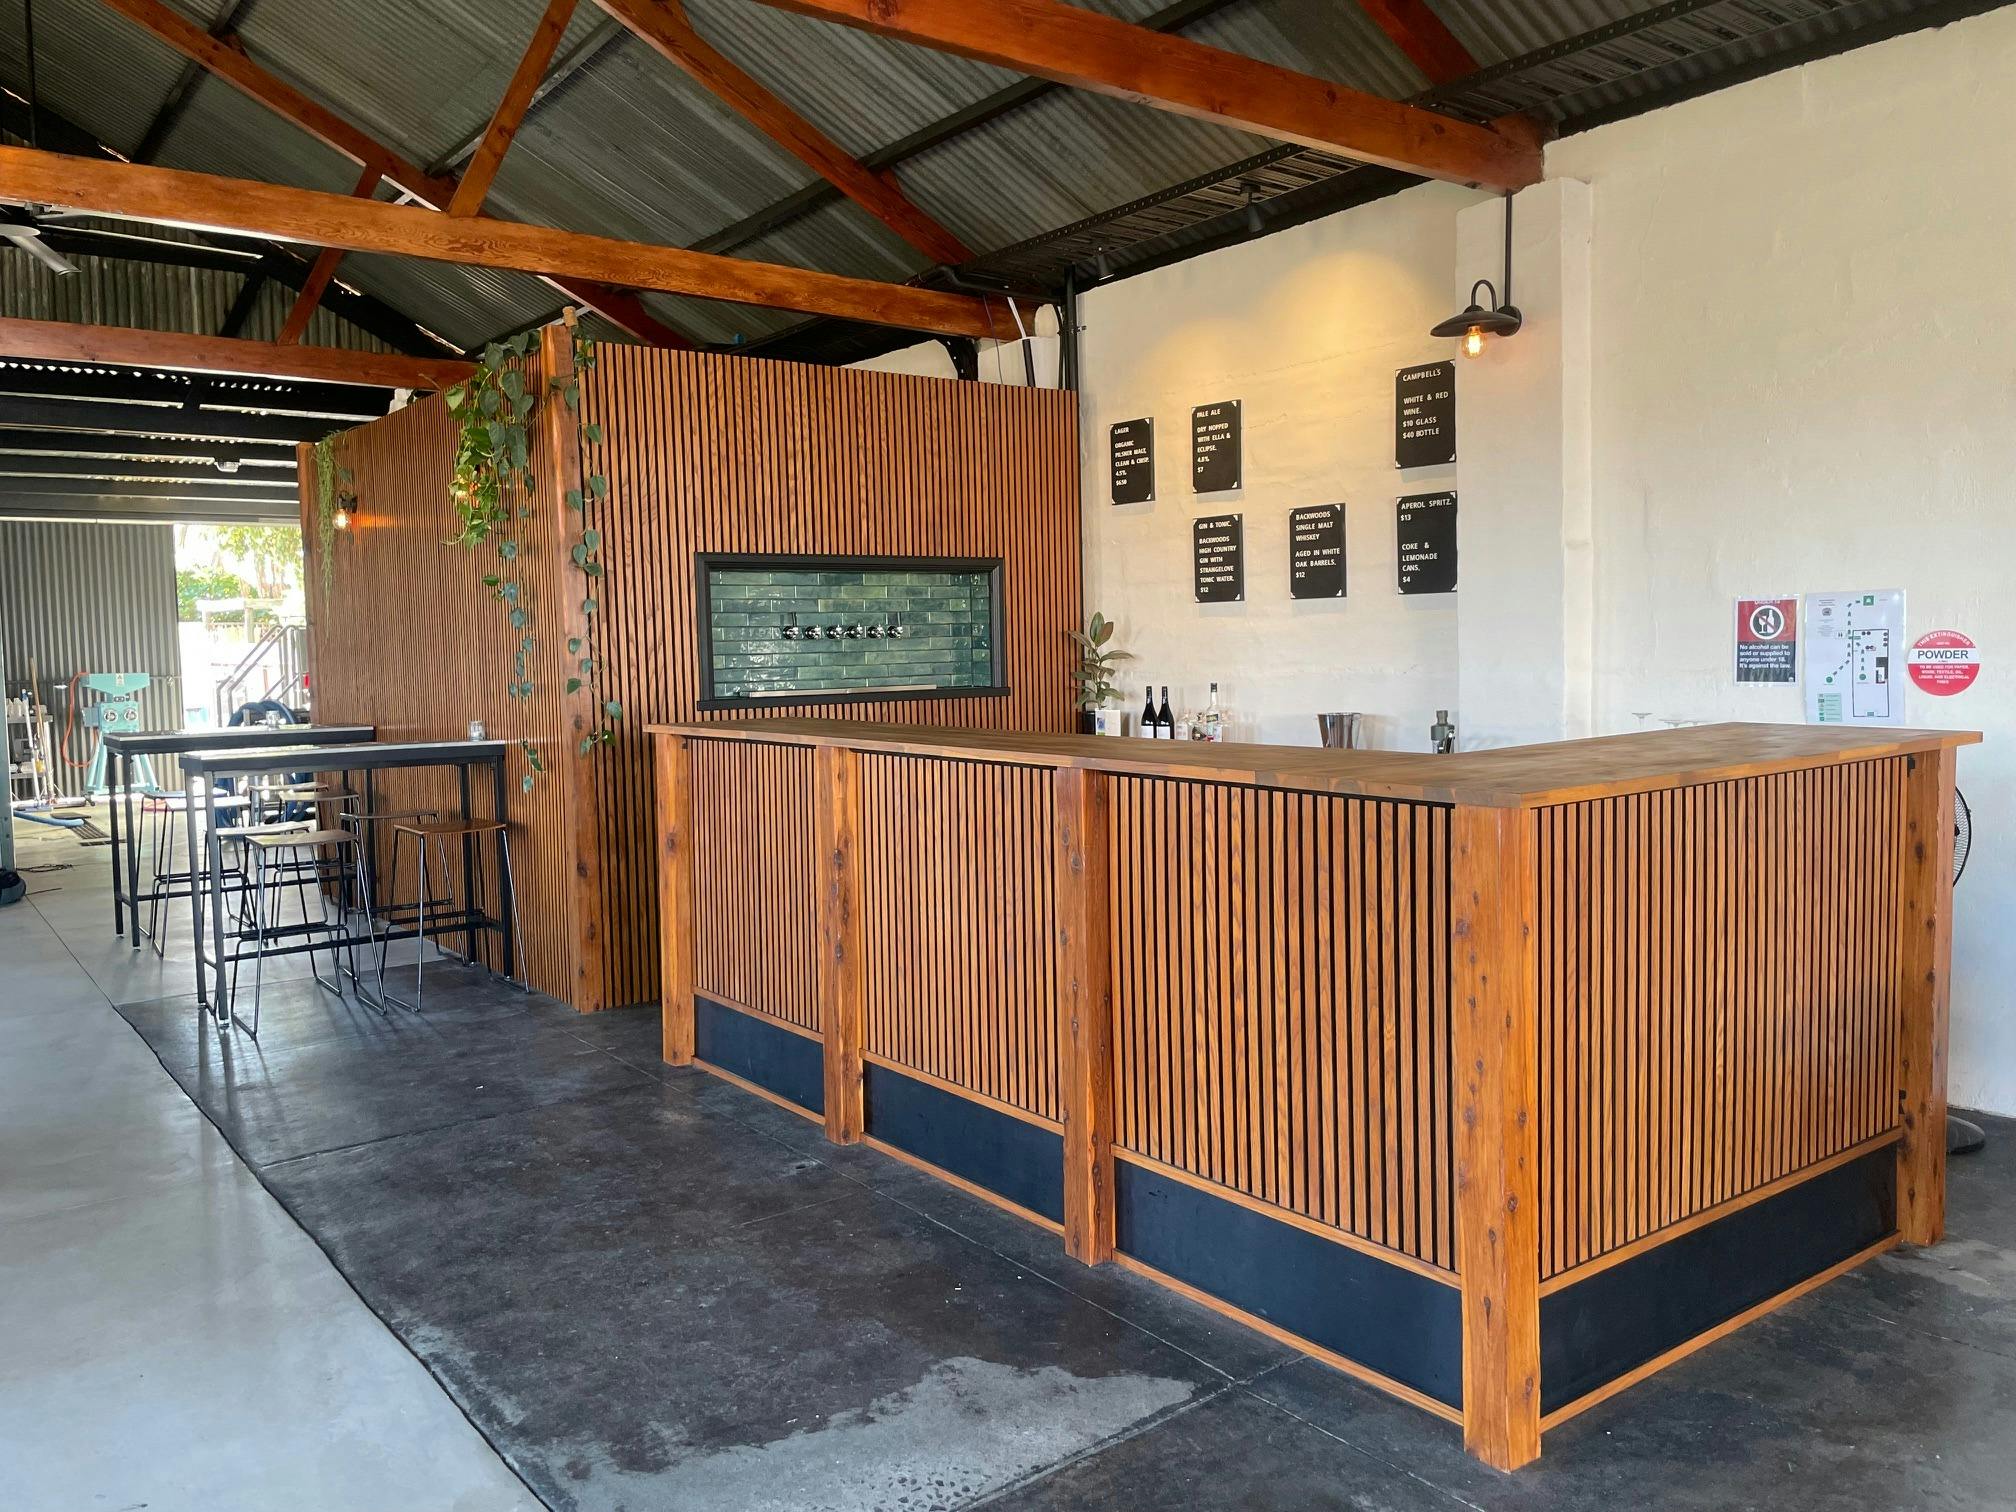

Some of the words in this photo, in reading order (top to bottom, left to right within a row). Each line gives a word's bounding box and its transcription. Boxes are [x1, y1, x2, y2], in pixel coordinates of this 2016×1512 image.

[1402, 368, 1441, 382] CAMPBELL'S
[1403, 394, 1424, 405] WHITE
[1426, 393, 1432, 401] &
[1435, 391, 1449, 400] RED
[1196, 410, 1209, 418] PALE
[1210, 408, 1221, 416] ALE
[1403, 407, 1421, 416] WINE.
[1402, 419, 1414, 428] $10
[1415, 416, 1437, 426] GLASS
[1114, 426, 1130, 435] LAGER
[1208, 422, 1229, 432] HOPPED
[1197, 435, 1210, 443] WITH
[1211, 433, 1225, 441] ELLA
[1402, 431, 1415, 440] $40
[1415, 427, 1440, 438] BOTTLE
[1114, 440, 1135, 449] ORGANIC
[1115, 459, 1130, 467] CLEAN
[1401, 501, 1426, 510] APEROL
[1295, 511, 1331, 521] BACKWOODS
[1400, 513, 1412, 522] $13
[1198, 522, 1208, 530] GIN
[1295, 523, 1316, 532] SINGLE
[1317, 521, 1334, 530] MALT
[1198, 535, 1230, 545] BACKWOODS
[1295, 533, 1320, 542] WHISKEY
[1213, 545, 1237, 553] COUNTRY
[1401, 542, 1419, 551] COKE
[1424, 541, 1430, 549] &
[1295, 549, 1312, 558] AGED
[1321, 547, 1341, 556] WHITE
[1402, 552, 1438, 561] LEMONADE
[1295, 560, 1308, 568] OAK
[1309, 558, 1337, 567] BARRELS.
[1199, 565, 1235, 574] STRANGELOVE
[1402, 564, 1421, 572] CANS.
[1295, 571, 1306, 579] $12
[1199, 576, 1215, 584] TONIC
[1917, 649, 1969, 660] POWDER
